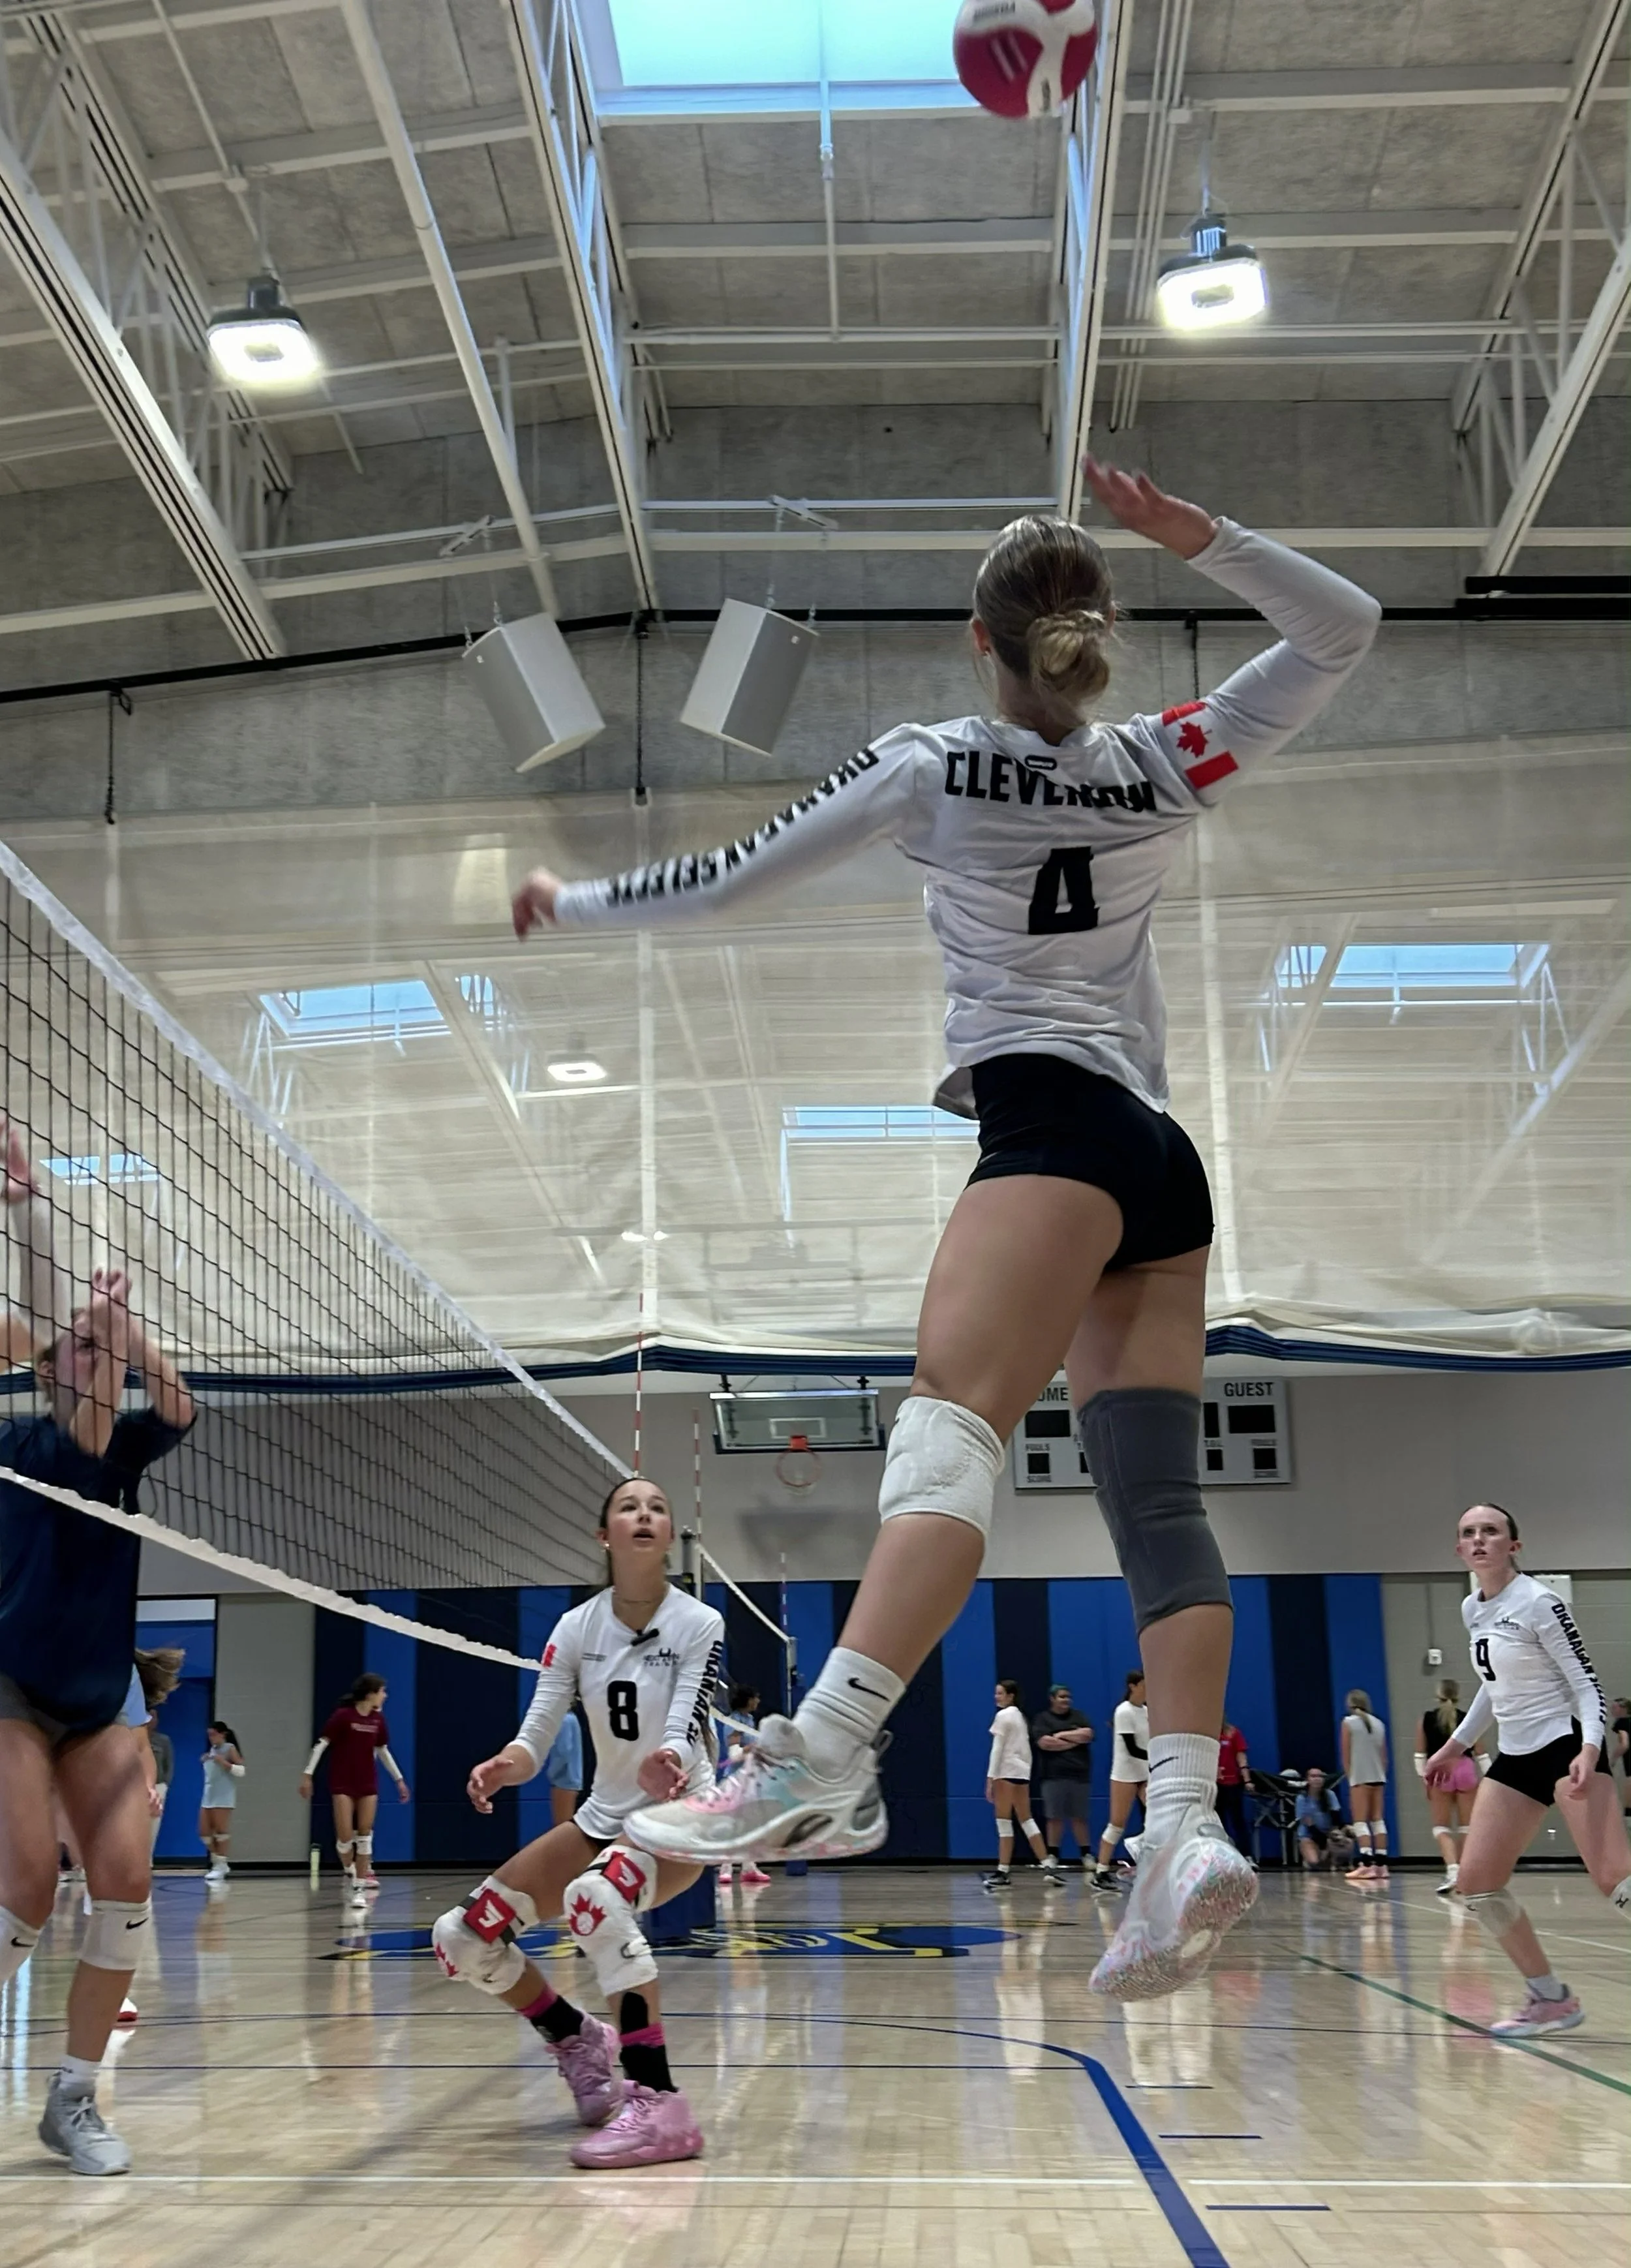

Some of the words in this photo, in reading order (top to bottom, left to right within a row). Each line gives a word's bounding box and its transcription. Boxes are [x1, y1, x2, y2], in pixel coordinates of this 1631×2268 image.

[1037, 1387, 1069, 1402] ME
[1224, 1382, 1274, 1397] GUEST
[1475, 1638, 1496, 1681] 9
[607, 1679, 639, 1741] 8
